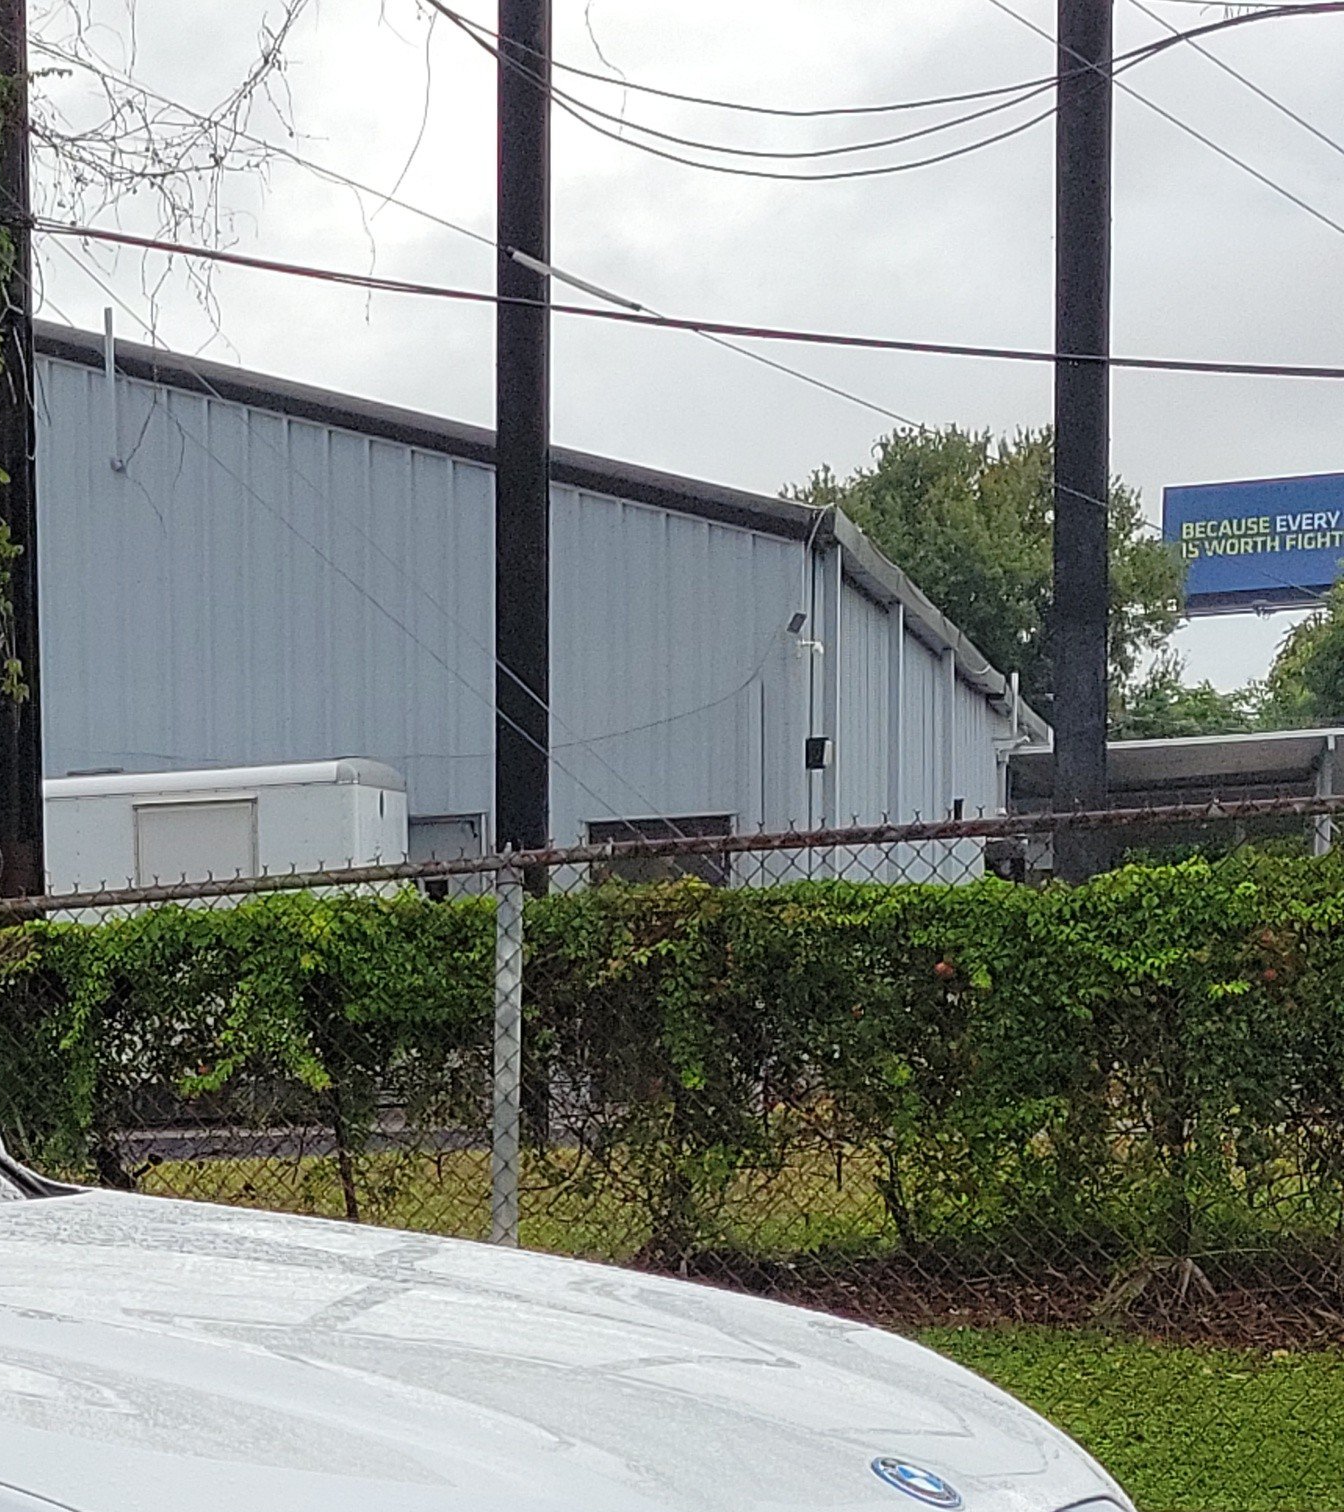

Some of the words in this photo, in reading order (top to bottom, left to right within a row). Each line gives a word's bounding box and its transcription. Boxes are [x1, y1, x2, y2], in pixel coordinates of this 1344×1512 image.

[1182, 517, 1270, 540] BECAUSE
[1276, 510, 1341, 532] EVERY
[1181, 540, 1200, 558] IS
[1204, 535, 1281, 556] WORTH
[1285, 530, 1344, 551] FIGHT
